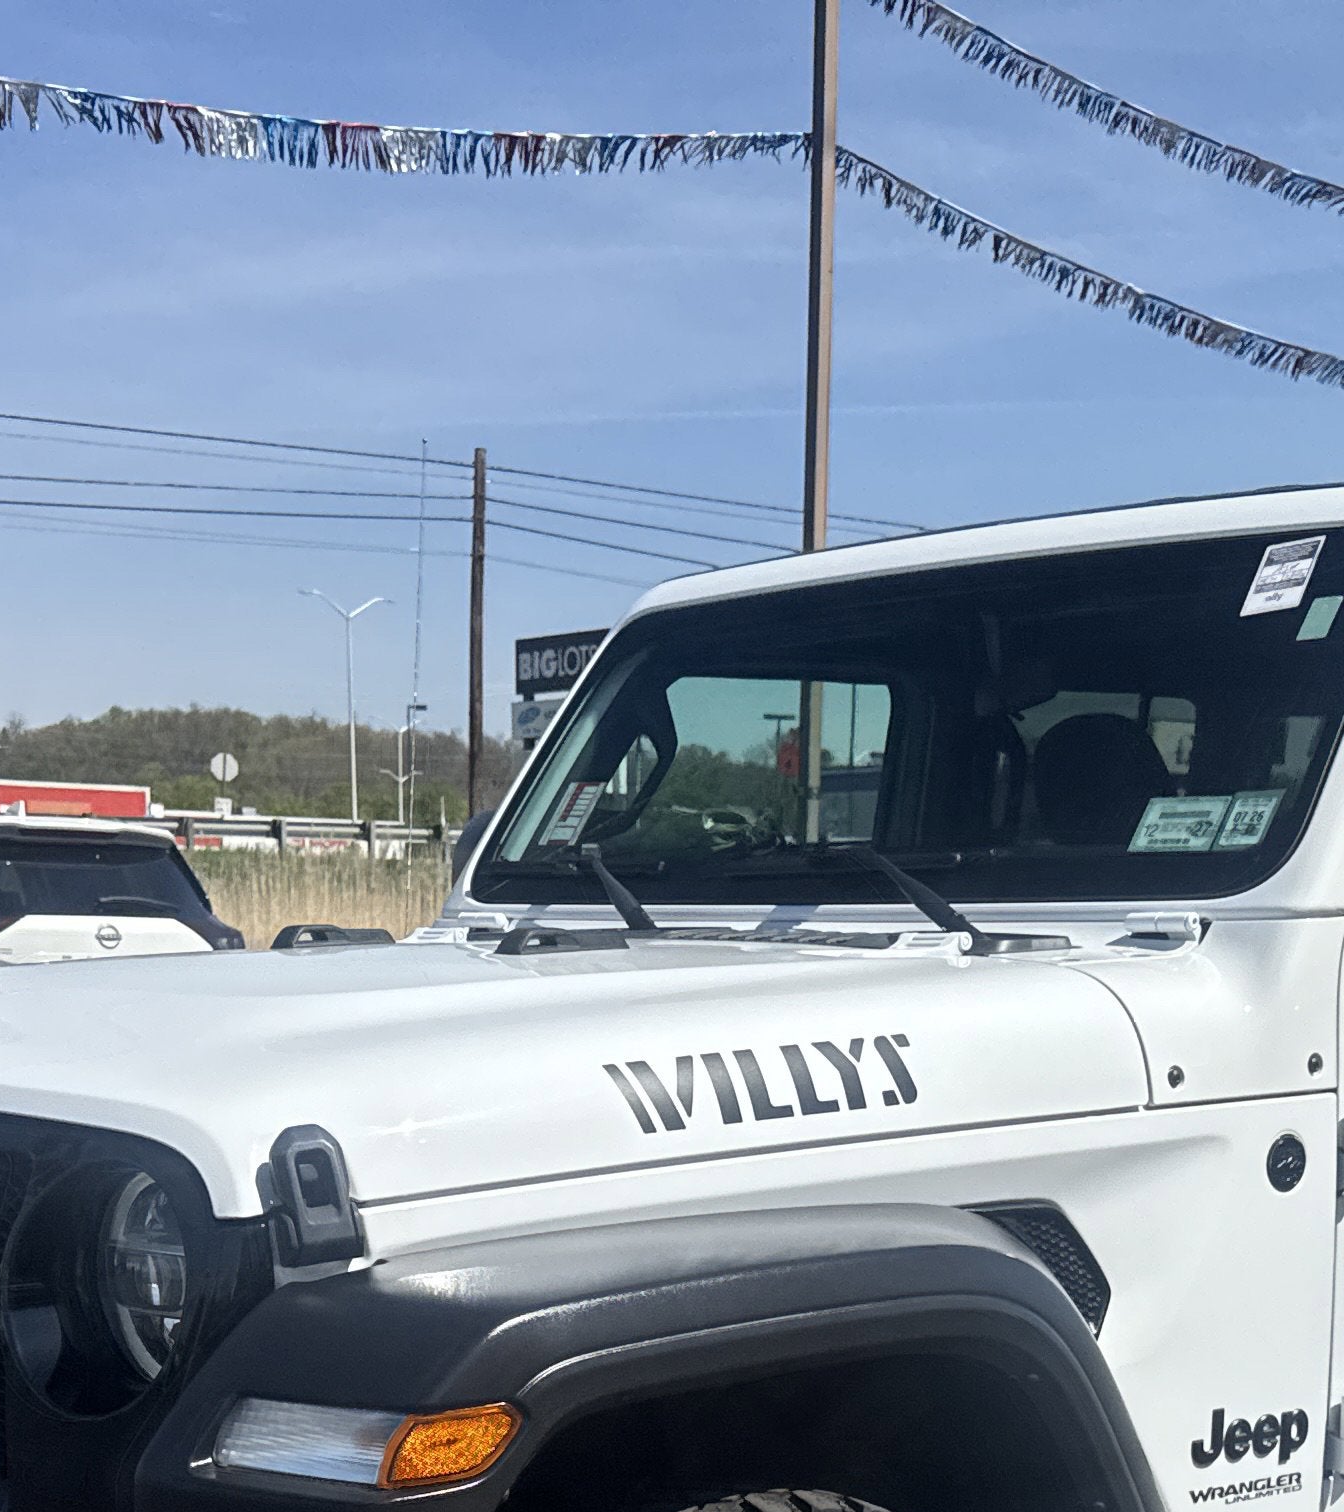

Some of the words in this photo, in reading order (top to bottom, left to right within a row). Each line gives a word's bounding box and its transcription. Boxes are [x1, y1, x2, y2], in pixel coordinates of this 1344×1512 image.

[601, 1033, 918, 1134] WILLYS
[1190, 1407, 1309, 1470] Jeep
[1189, 1471, 1303, 1505] WRANGLER
[1224, 1482, 1303, 1506] UNLIMITED
